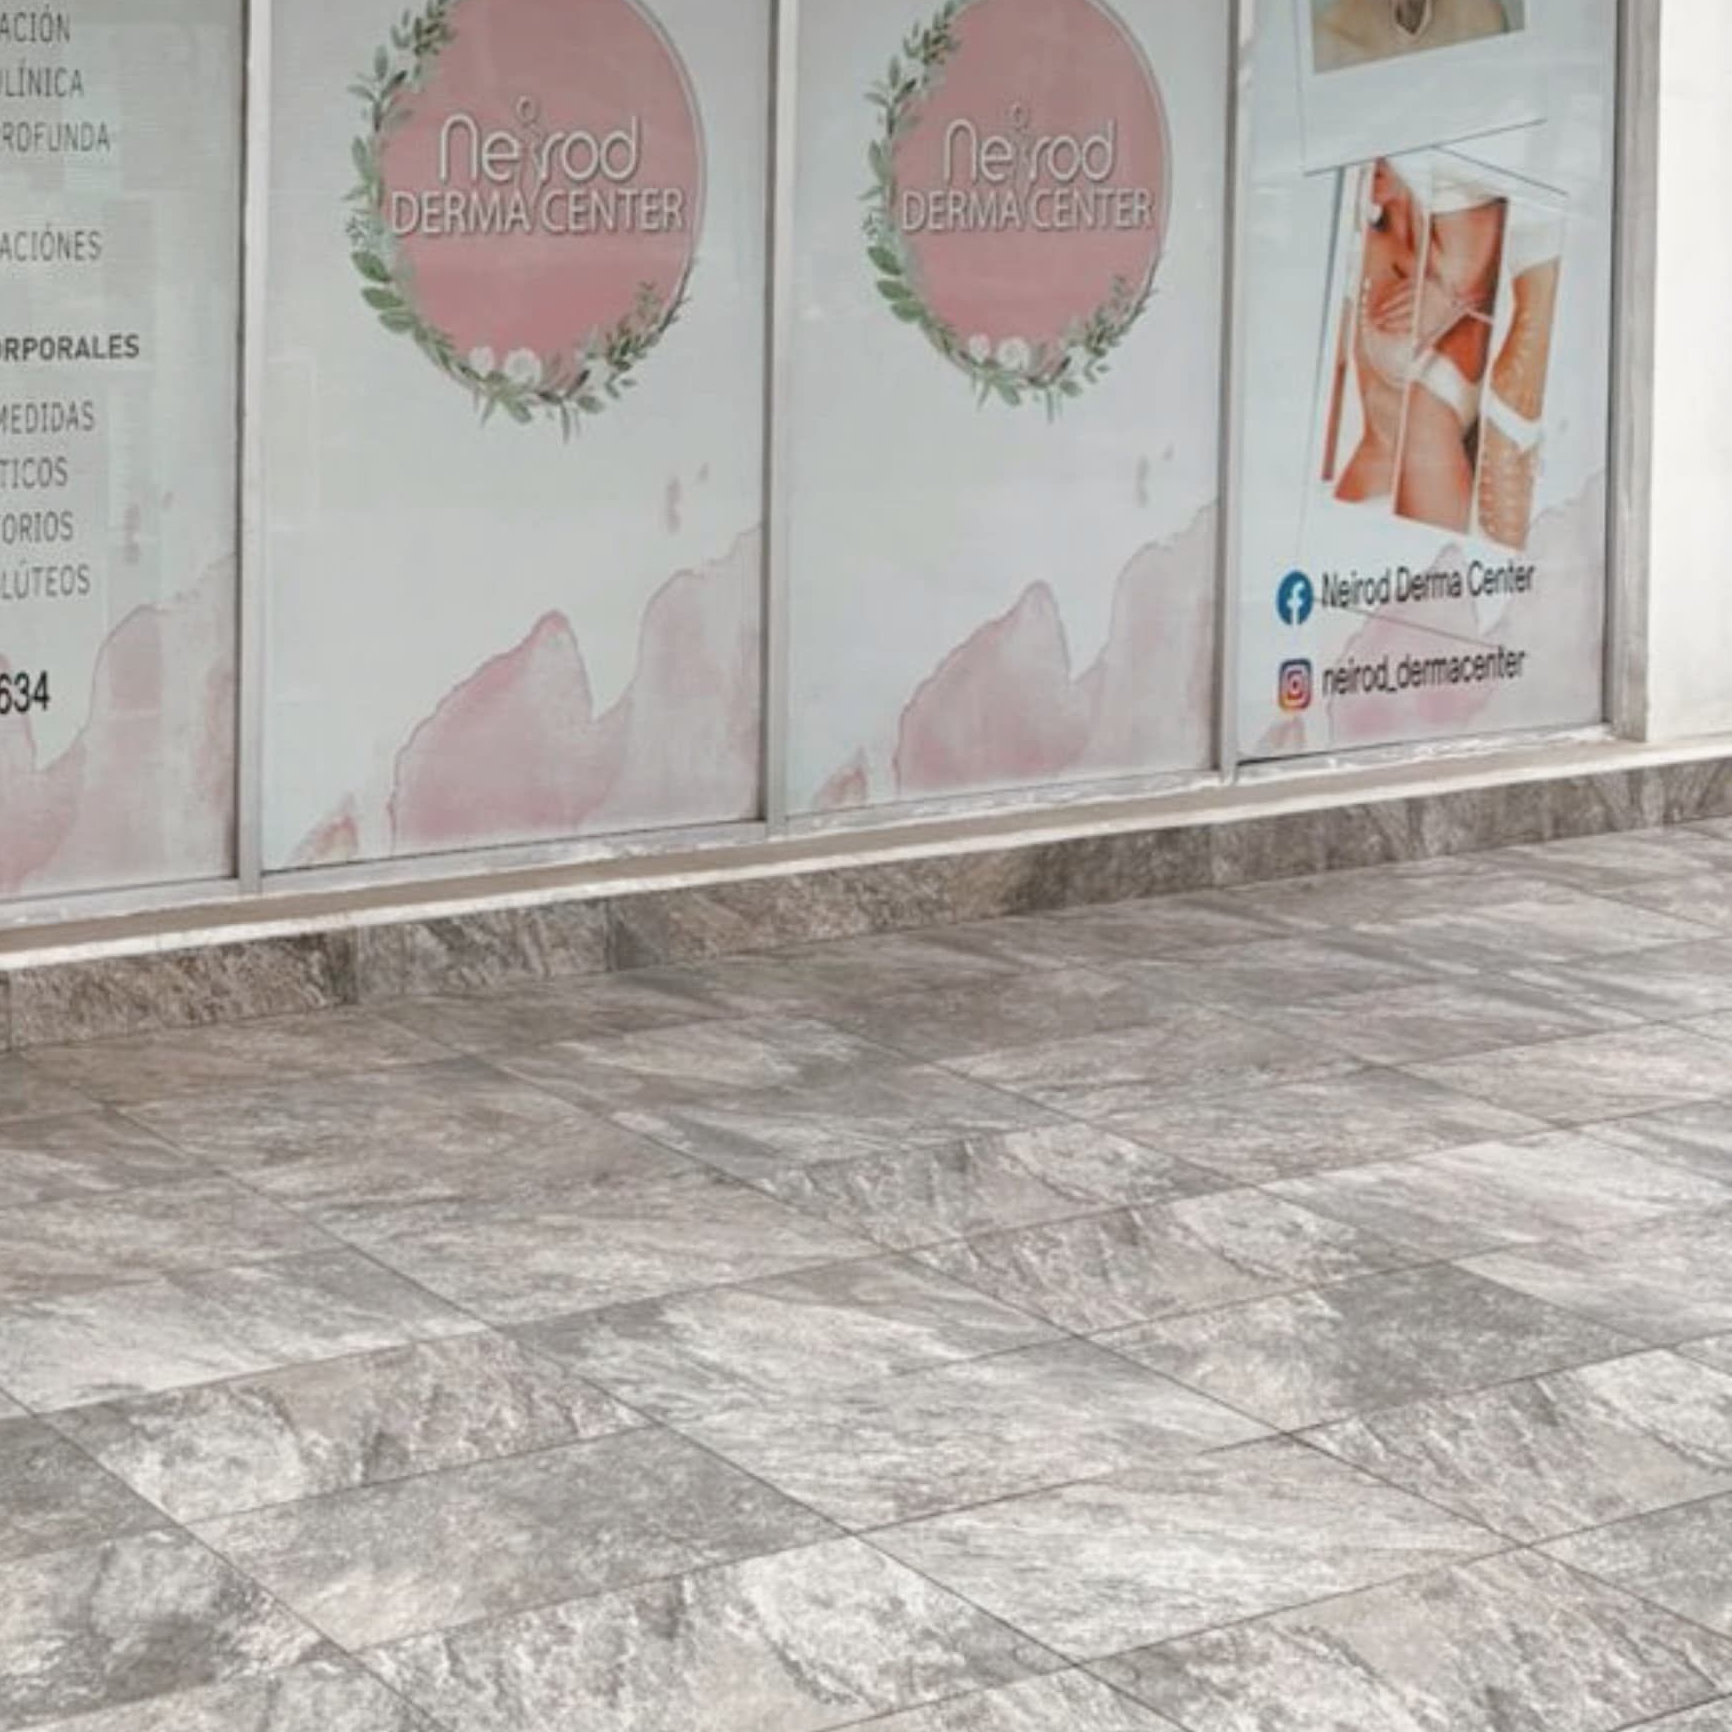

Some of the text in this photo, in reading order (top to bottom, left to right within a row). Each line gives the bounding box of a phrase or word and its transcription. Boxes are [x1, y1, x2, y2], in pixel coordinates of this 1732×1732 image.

[391, 187, 687, 236] DERMA CENTER
[901, 187, 1154, 233] DERMA CENTER
[1320, 559, 1535, 609] Neirod Derma Center
[1321, 645, 1527, 697] neirod_dermacenter
